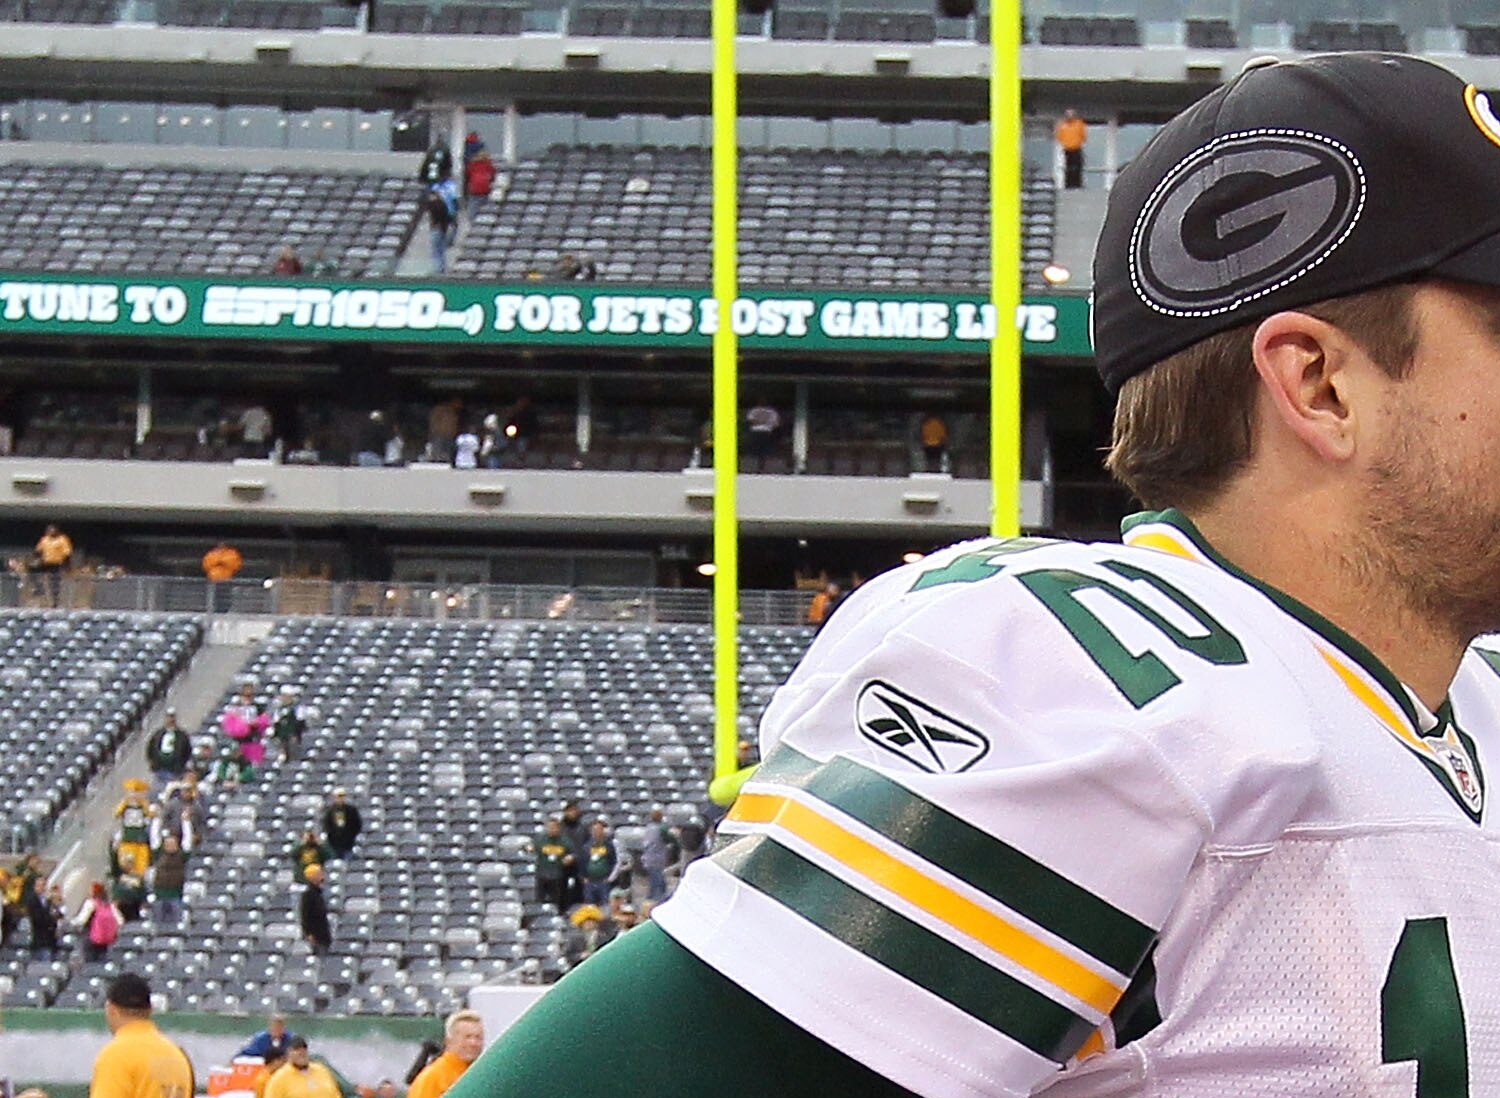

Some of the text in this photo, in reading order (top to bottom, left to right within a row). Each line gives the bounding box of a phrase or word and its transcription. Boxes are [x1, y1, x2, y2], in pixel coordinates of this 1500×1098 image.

[1147, 147, 1339, 294] G
[1, 282, 119, 324] TUNE
[125, 285, 187, 325] TO
[494, 295, 582, 333] FOR
[586, 297, 694, 335] JETS
[820, 299, 949, 339] GAME
